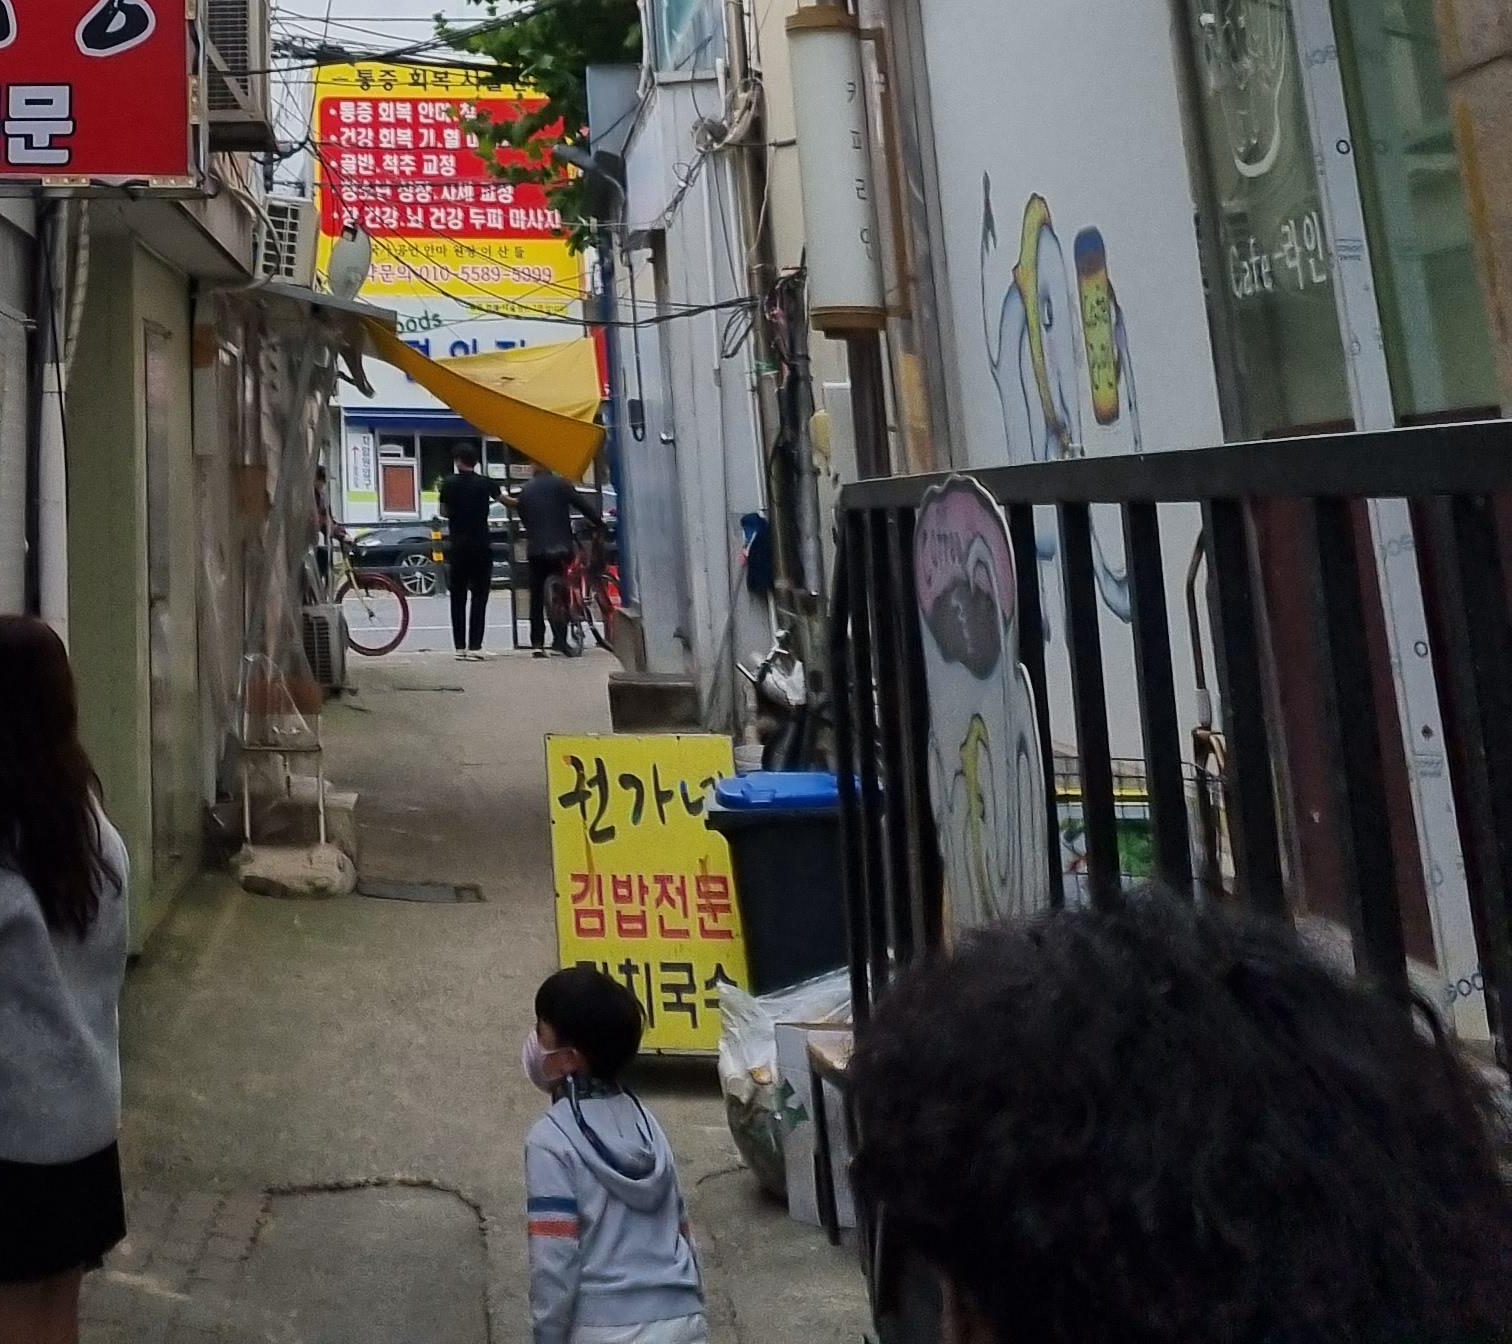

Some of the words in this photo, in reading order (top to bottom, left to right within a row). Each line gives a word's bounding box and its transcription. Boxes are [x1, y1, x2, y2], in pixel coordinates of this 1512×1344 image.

[339, 101, 373, 124] 통증
[378, 101, 412, 124] 회복
[340, 127, 375, 149] 건강
[379, 127, 412, 149] 회복
[421, 153, 457, 177] 교정
[429, 206, 465, 230] 건강
[469, 206, 504, 231] 두피
[509, 207, 562, 231] 마사지
[569, 871, 735, 942] 김밥전문
[575, 957, 740, 1030] 치국수
